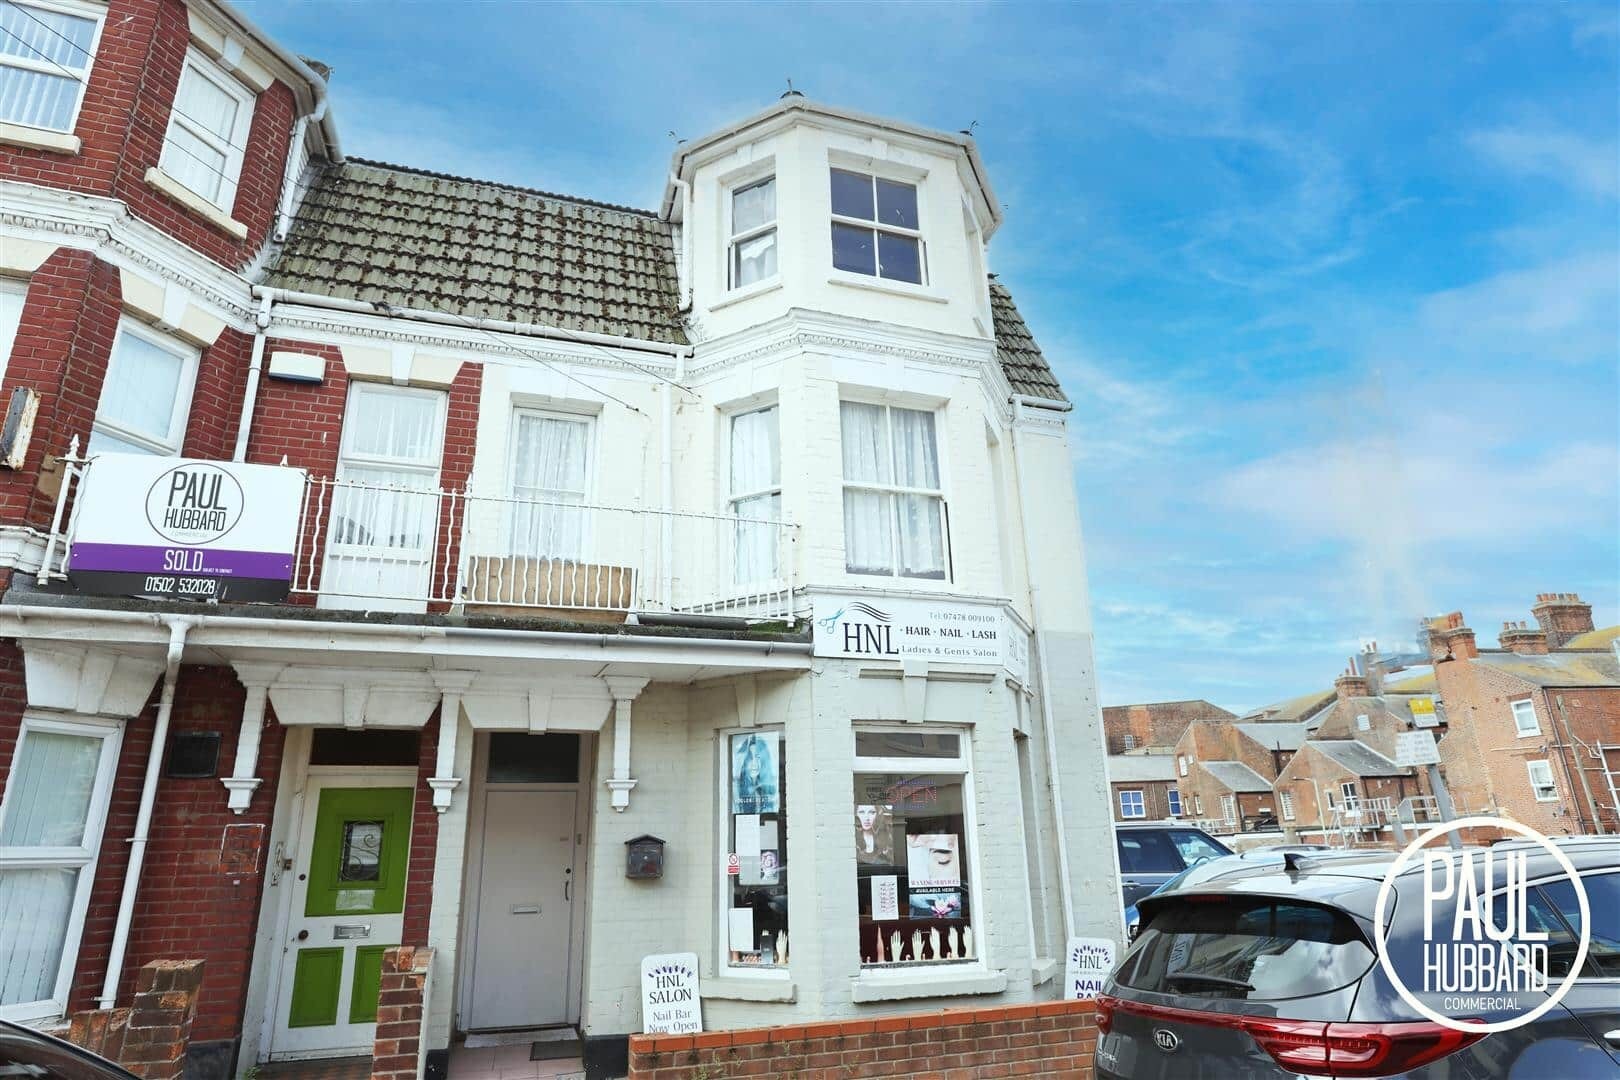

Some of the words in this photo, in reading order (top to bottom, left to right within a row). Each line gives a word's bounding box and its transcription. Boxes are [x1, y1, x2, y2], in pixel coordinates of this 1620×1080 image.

[168, 471, 227, 510] PAUL
[164, 508, 226, 531] HUBBARD
[164, 549, 204, 572] SOLD
[145, 576, 175, 593] 01502
[178, 577, 216, 595] 532028
[842, 622, 899, 655] HNL
[905, 626, 932, 636] HAIR
[940, 628, 964, 638] NAIL
[972, 630, 997, 640] LASH
[902, 645, 932, 654] Ladies
[934, 646, 941, 655] &
[944, 647, 971, 656] Gents
[973, 648, 998, 657] Salon
[1079, 955, 1103, 969] HNL
[656, 975, 685, 988] HNL
[649, 988, 693, 1004] SALON
[653, 1010, 672, 1021] Nail
[675, 1009, 691, 1020] Bar
[673, 1021, 698, 1033] Open
[1156, 1032, 1175, 1047] KIA
